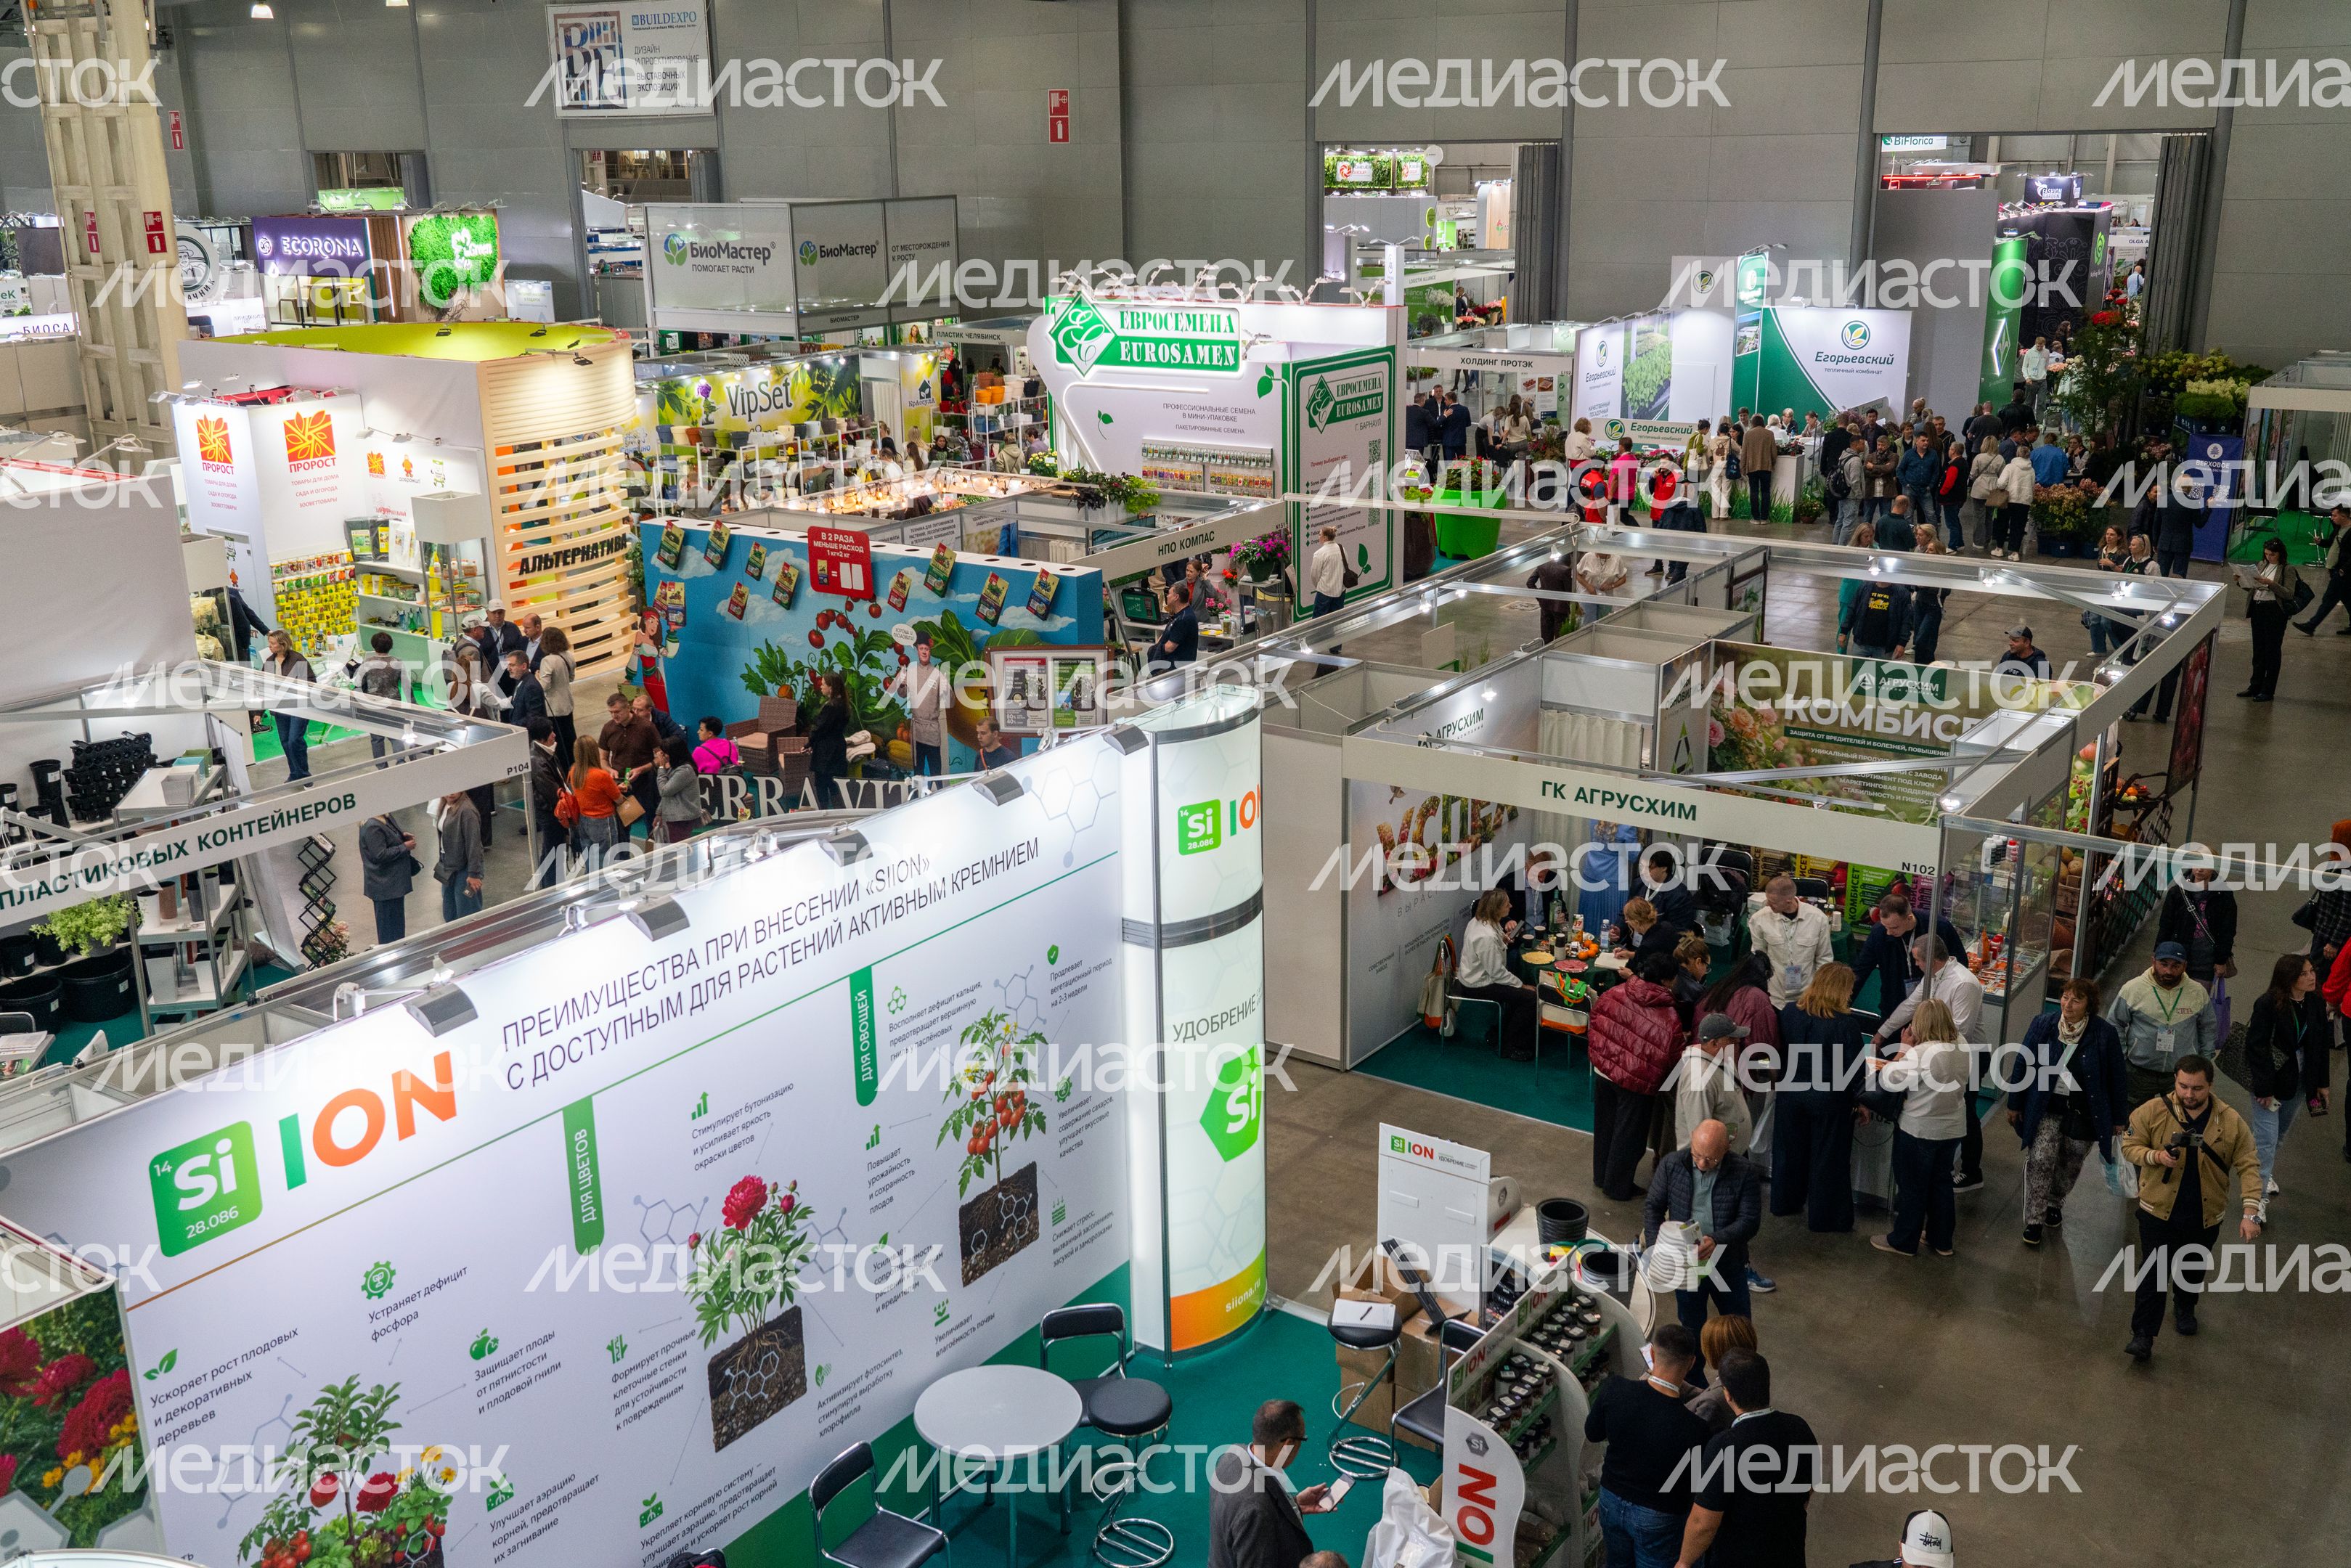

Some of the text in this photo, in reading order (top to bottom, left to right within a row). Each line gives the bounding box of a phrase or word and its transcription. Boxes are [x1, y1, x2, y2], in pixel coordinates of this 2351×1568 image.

[640, 12, 696, 25] BUILDEXPO
[635, 46, 660, 55] ДИЗАЙН
[641, 54, 699, 65] ПРОЕКТИРОВАНИЕ
[637, 71, 685, 81] ВЫСТАВОЧНЫХ
[282, 237, 363, 258] ECORONA
[901, 241, 950, 252] МЕСТОРОЖДЕНИЯ
[692, 265, 730, 274] ПОМОГАЕТ
[830, 315, 860, 324] БИОМАСТЕР
[1119, 309, 1235, 334] ЕВРОСЕМЕНА
[1120, 340, 1236, 366] EUROSAMEN
[1460, 356, 1533, 369] ХОЛДИНГ ПРОТЭК
[1815, 351, 1894, 365] Егорьевский
[1336, 377, 1382, 397] ЕВРОСЕМЕНА
[1585, 367, 1616, 383] Егорьевский
[726, 378, 793, 421] VipSet
[1162, 403, 1229, 414] ПРОФЕССИОНАЛЬНЫЕ
[1336, 396, 1382, 417] EUROSAMEN
[1188, 413, 1237, 422] МИНИ-УПАКОВКЕ
[1360, 419, 1381, 430] БАРНАУЛ
[1631, 422, 1693, 435] Егорьевский
[202, 462, 234, 475] ПРОРОСТ
[289, 458, 336, 473] ПРОРОСТ
[299, 497, 338, 508] ЗООВЕТТОВАРЫ
[813, 540, 864, 553] МЕНЬШЕ РАСХОД
[834, 534, 854, 543] РАЗА
[1157, 530, 1215, 557] НПО КОМПАС
[519, 533, 627, 576] АЛЬТЕРНАТИВА
[1879, 677, 1939, 692] АГРУСХИМ
[1437, 708, 1483, 738] АГРУСХИМ
[1790, 730, 1815, 738] ЗАЩИТА
[1826, 735, 1865, 746] ВРЕДИТЕЛЕЙ
[1873, 740, 1907, 751] БОЛЕЗНЕЙ,
[1908, 746, 1950, 756] ПОВЫШЕНИЕ
[698, 773, 820, 820] ERRA
[1541, 780, 1698, 822] ГК АГРУСХИМ
[197, 792, 357, 852] КОНТЕЙНЕРОВ
[1187, 807, 1213, 838] Si
[1187, 838, 1214, 850] 28.086
[1902, 862, 1935, 875] N102
[1849, 867, 1860, 920] КОМБИСЕТ
[502, 853, 931, 1052] ПРЕИМУЩЕСТВА ПРИ ВНЕСЕНИИ «SIION»
[508, 837, 1038, 1090] С ДОСТУПНЫМ ДЛЯ РАСТЕНИЙ АКТИВНЫМ КРЕМНИЕМ
[1050, 959, 1083, 982] Продлевает
[889, 981, 982, 1032] Восполняет дефицит кальция,
[1172, 997, 1256, 1043] УДОБРЕНИЕ
[857, 989, 872, 1082] ДЛЯ ОВОЩЕЙ
[691, 1083, 794, 1140] Стимулирует бутонизацию
[173, 1049, 457, 1211] Si ION
[867, 1147, 901, 1172] Повышает
[1394, 1139, 1434, 1160] Si ION
[1438, 1156, 1464, 1167] УДОБРЕНИЕ
[153, 1159, 173, 1177] 14
[575, 1129, 595, 1223] ДЛЯ ЦВЕТОВ
[868, 1156, 910, 1188] урожайность
[185, 1205, 240, 1241] 28.086
[1052, 1222, 1076, 1242] Снижает
[368, 1266, 468, 1324] Устраняет дефицит
[1225, 1278, 1262, 1314] siiona.ru
[371, 1310, 419, 1342] фосфора
[935, 1314, 973, 1344] Увеличивает
[936, 1312, 995, 1357] влагоёмкость почвы
[150, 1327, 298, 1408] Ускоряет рост плодовых
[474, 1330, 555, 1381] Защищает плоды
[611, 1328, 696, 1384] Формирует прочные
[476, 1352, 547, 1398] от пятнистости
[817, 1349, 903, 1410] Активизирует фотосинтез,
[154, 1370, 253, 1427] и декоративных
[156, 1409, 216, 1447] деревьев
[1471, 1437, 1483, 1450] Si
[489, 1472, 576, 1532] Улучшает аэрацию
[1456, 1463, 1497, 1564] ION
